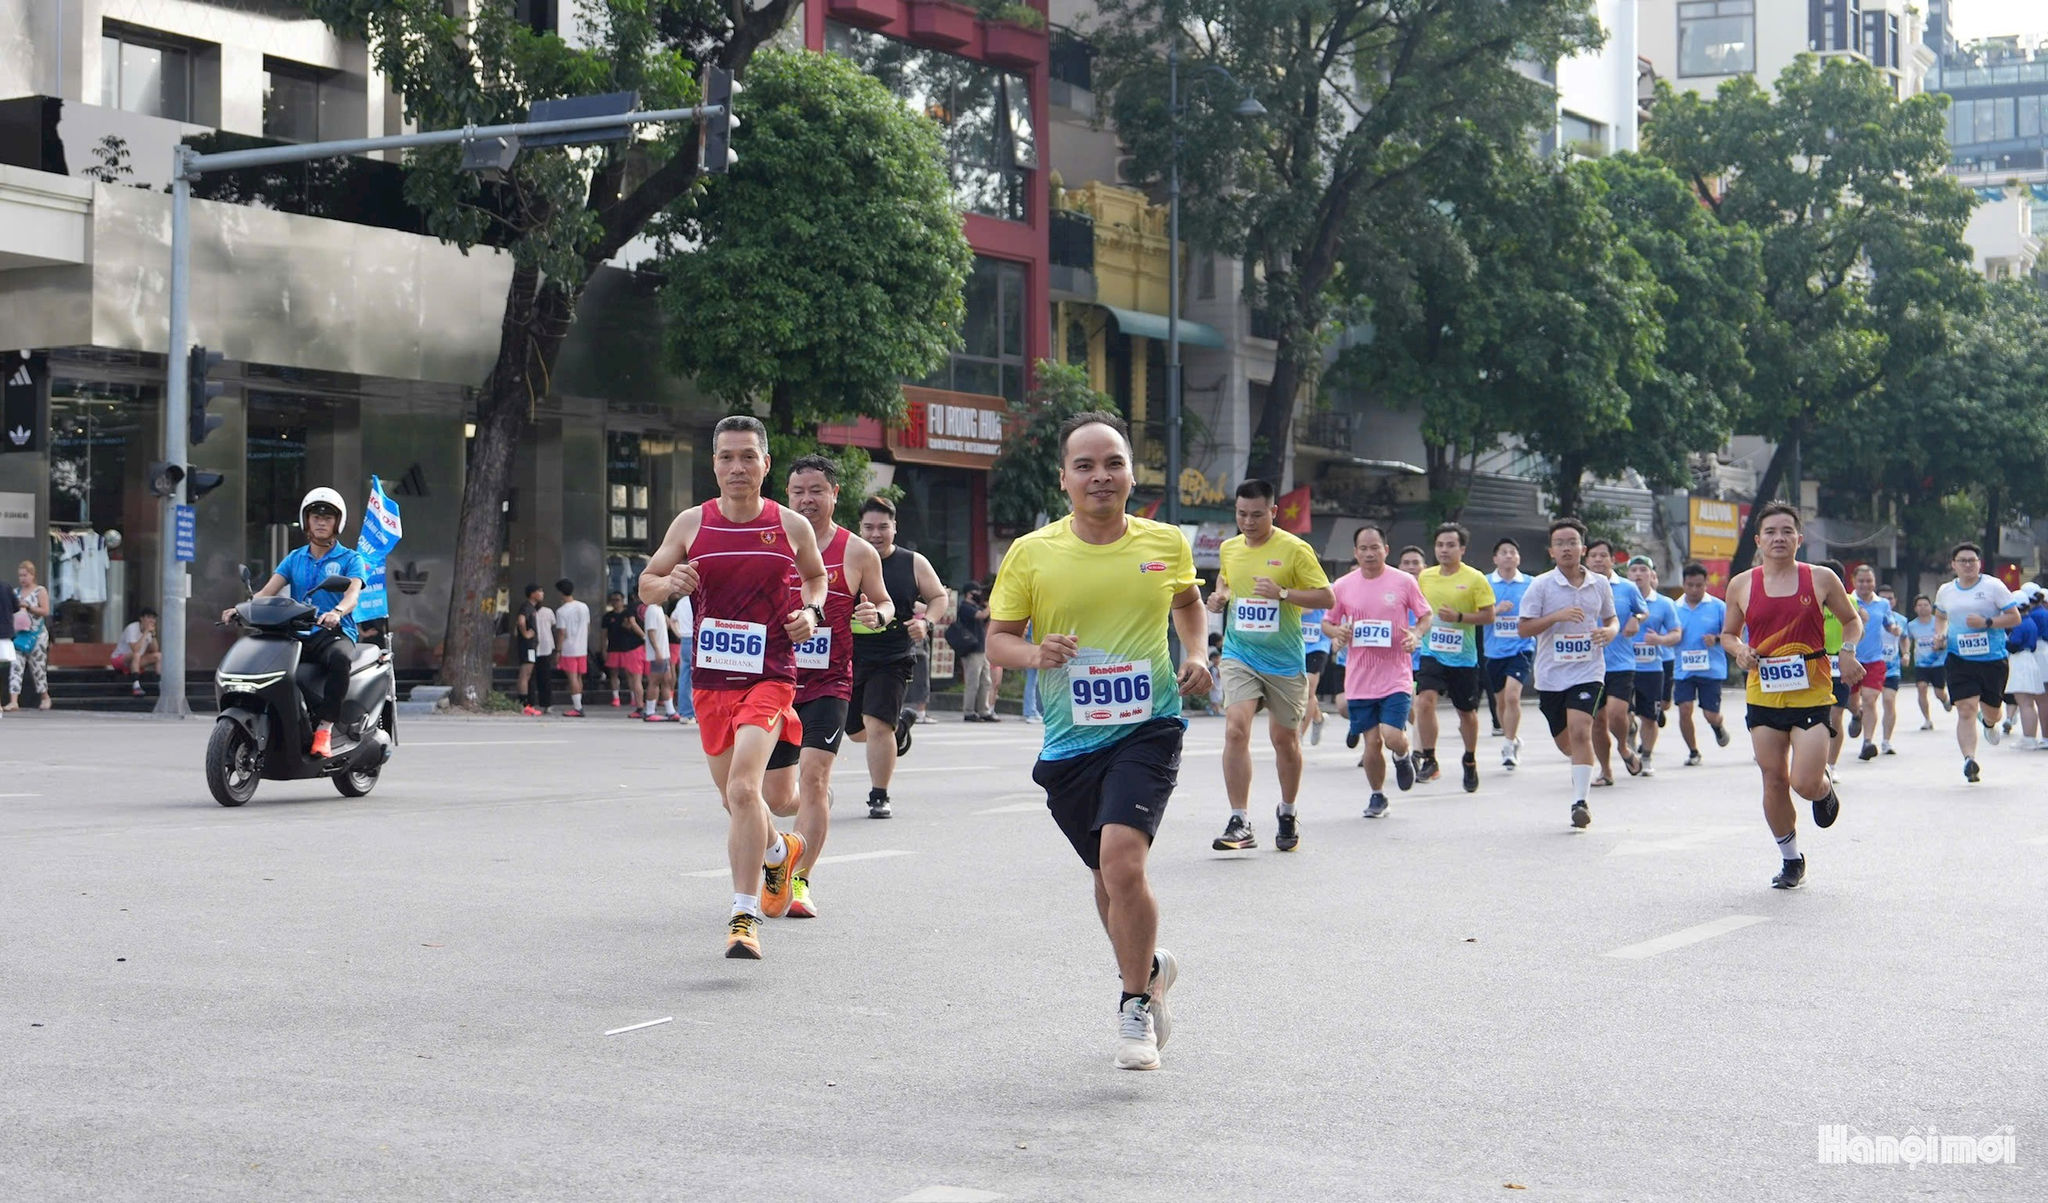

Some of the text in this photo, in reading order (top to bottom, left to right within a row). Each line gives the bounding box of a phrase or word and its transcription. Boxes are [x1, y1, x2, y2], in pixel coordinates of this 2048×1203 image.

[928, 403, 944, 435] FU
[945, 405, 978, 438] RONG
[979, 408, 1002, 440] HUA
[369, 496, 397, 528] HODA
[1238, 606, 1278, 621] 9907
[1302, 627, 1320, 636] 919
[1355, 626, 1389, 638] 9976
[1496, 621, 1517, 630] 999
[700, 630, 762, 656] 9956
[1431, 632, 1462, 645] 9902
[1959, 637, 1988, 648] 9933
[1555, 640, 1591, 653] 9903
[1634, 646, 1655, 656] 918
[713, 658, 754, 668] AGRIBANK
[1682, 655, 1707, 664] 9927
[1760, 663, 1804, 681] 9963
[1073, 674, 1150, 705] 9906
